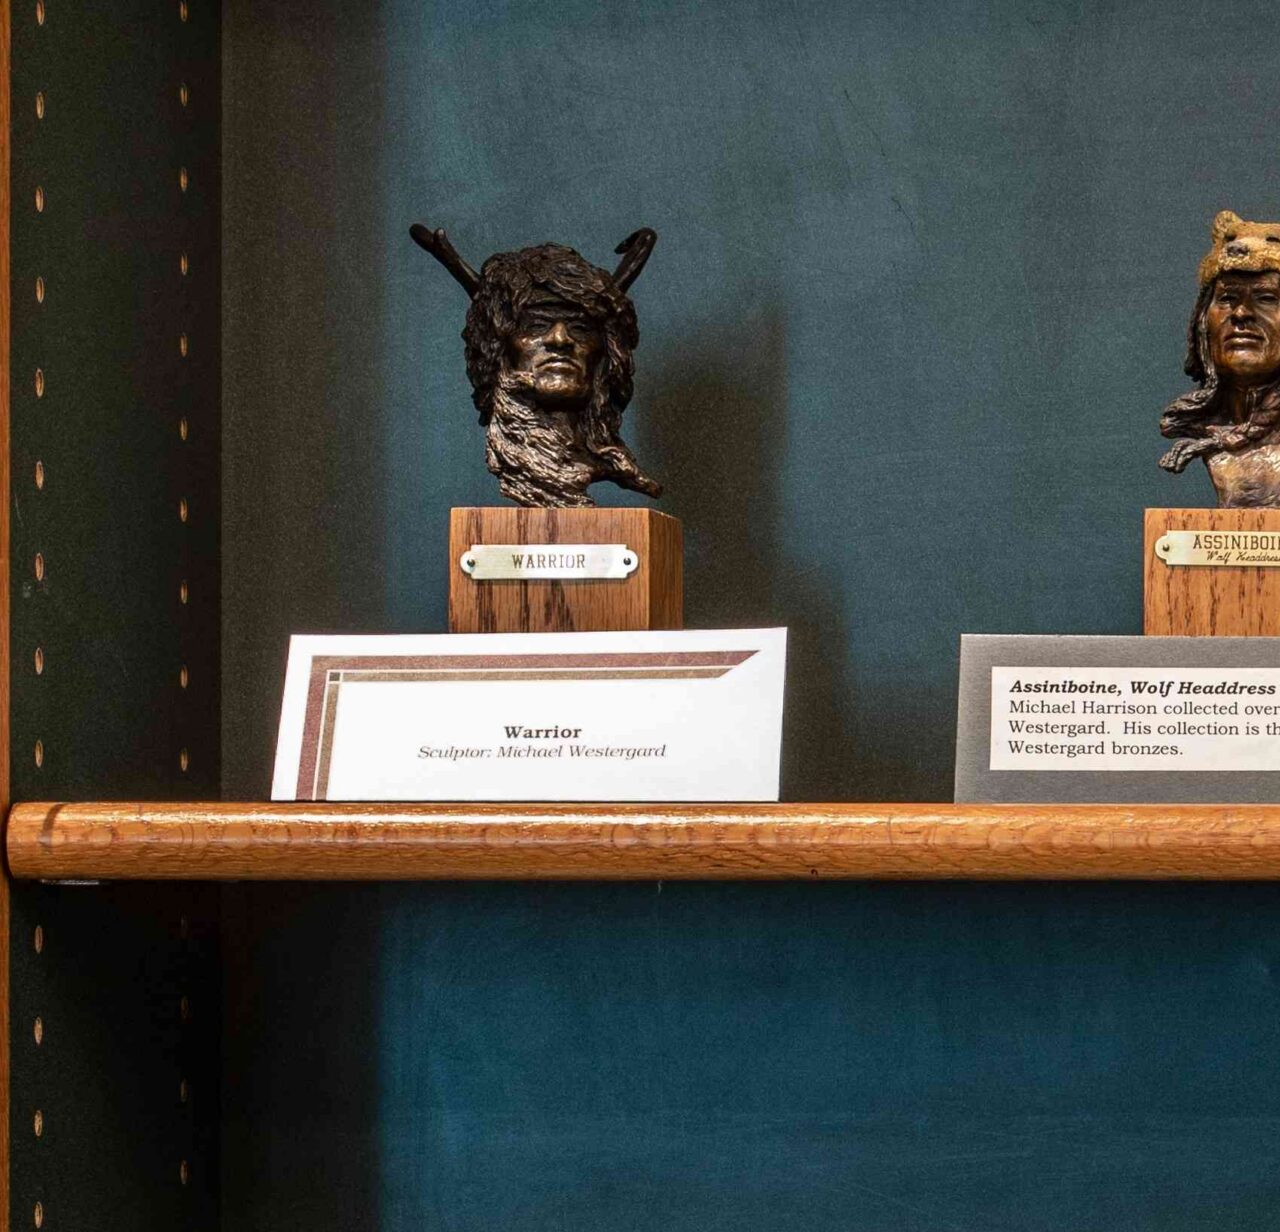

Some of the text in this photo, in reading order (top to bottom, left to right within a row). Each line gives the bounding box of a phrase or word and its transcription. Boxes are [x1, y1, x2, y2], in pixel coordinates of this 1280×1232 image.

[511, 553, 586, 569] WARRIOR
[1009, 679, 1122, 697] Assiniboine,
[1130, 680, 1174, 697] Wolf
[1177, 681, 1277, 695] Headdress
[1009, 699, 1076, 714] Michael
[1082, 700, 1158, 715] Harrison
[1163, 701, 1239, 716] collected
[1244, 705, 1280, 716] over
[503, 725, 583, 739] Warrior
[1008, 720, 1111, 738] Westergard.
[1123, 721, 1152, 735] His
[1157, 721, 1240, 736] collection
[1245, 721, 1260, 736] is
[417, 745, 666, 762] Sculptor: Michael Westergard
[1007, 740, 1184, 758] Westergard bronzes.
